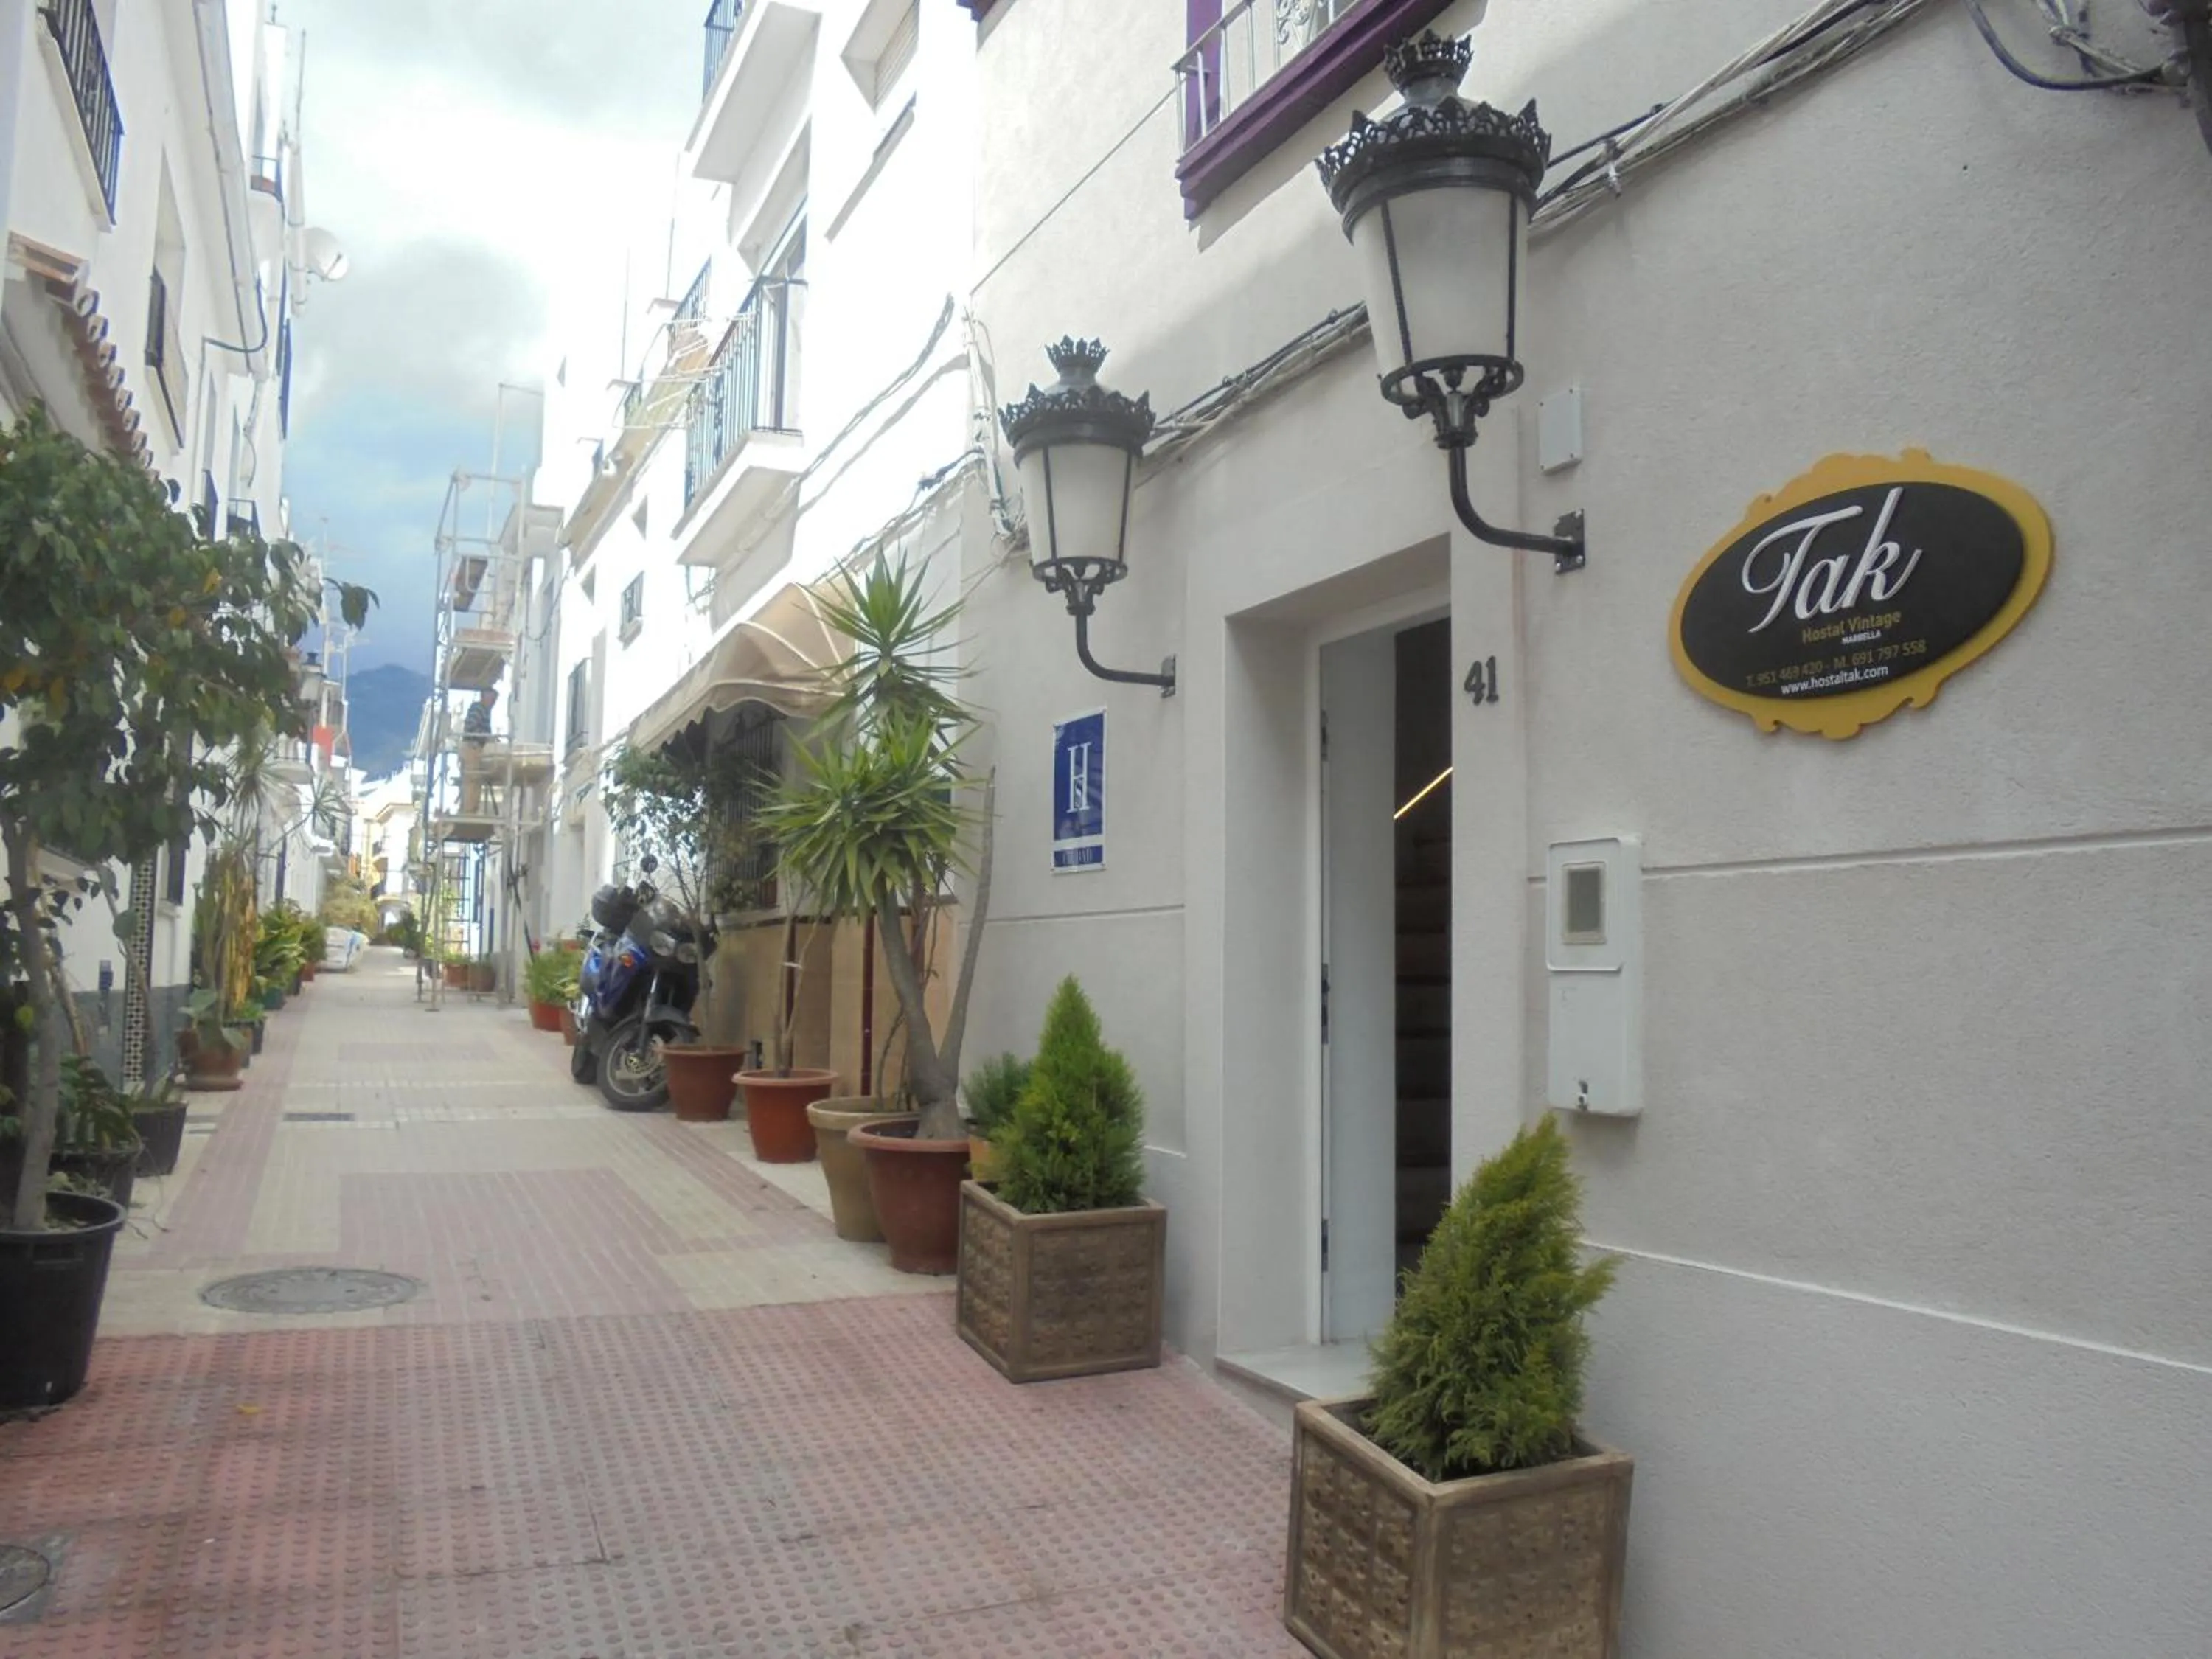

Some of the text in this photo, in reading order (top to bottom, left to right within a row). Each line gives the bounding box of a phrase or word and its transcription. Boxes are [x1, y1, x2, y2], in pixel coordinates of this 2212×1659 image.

[1741, 487, 1922, 633] Tak
[1801, 611, 1902, 644] Hostal Vintage
[1841, 630, 1882, 644] MARBELLA
[1851, 649, 1874, 666] 691
[1876, 644, 1899, 661] 797
[1902, 639, 1927, 657] 558
[1464, 655, 1499, 706] 41
[1781, 664, 1889, 695] www.hostaltak.com
